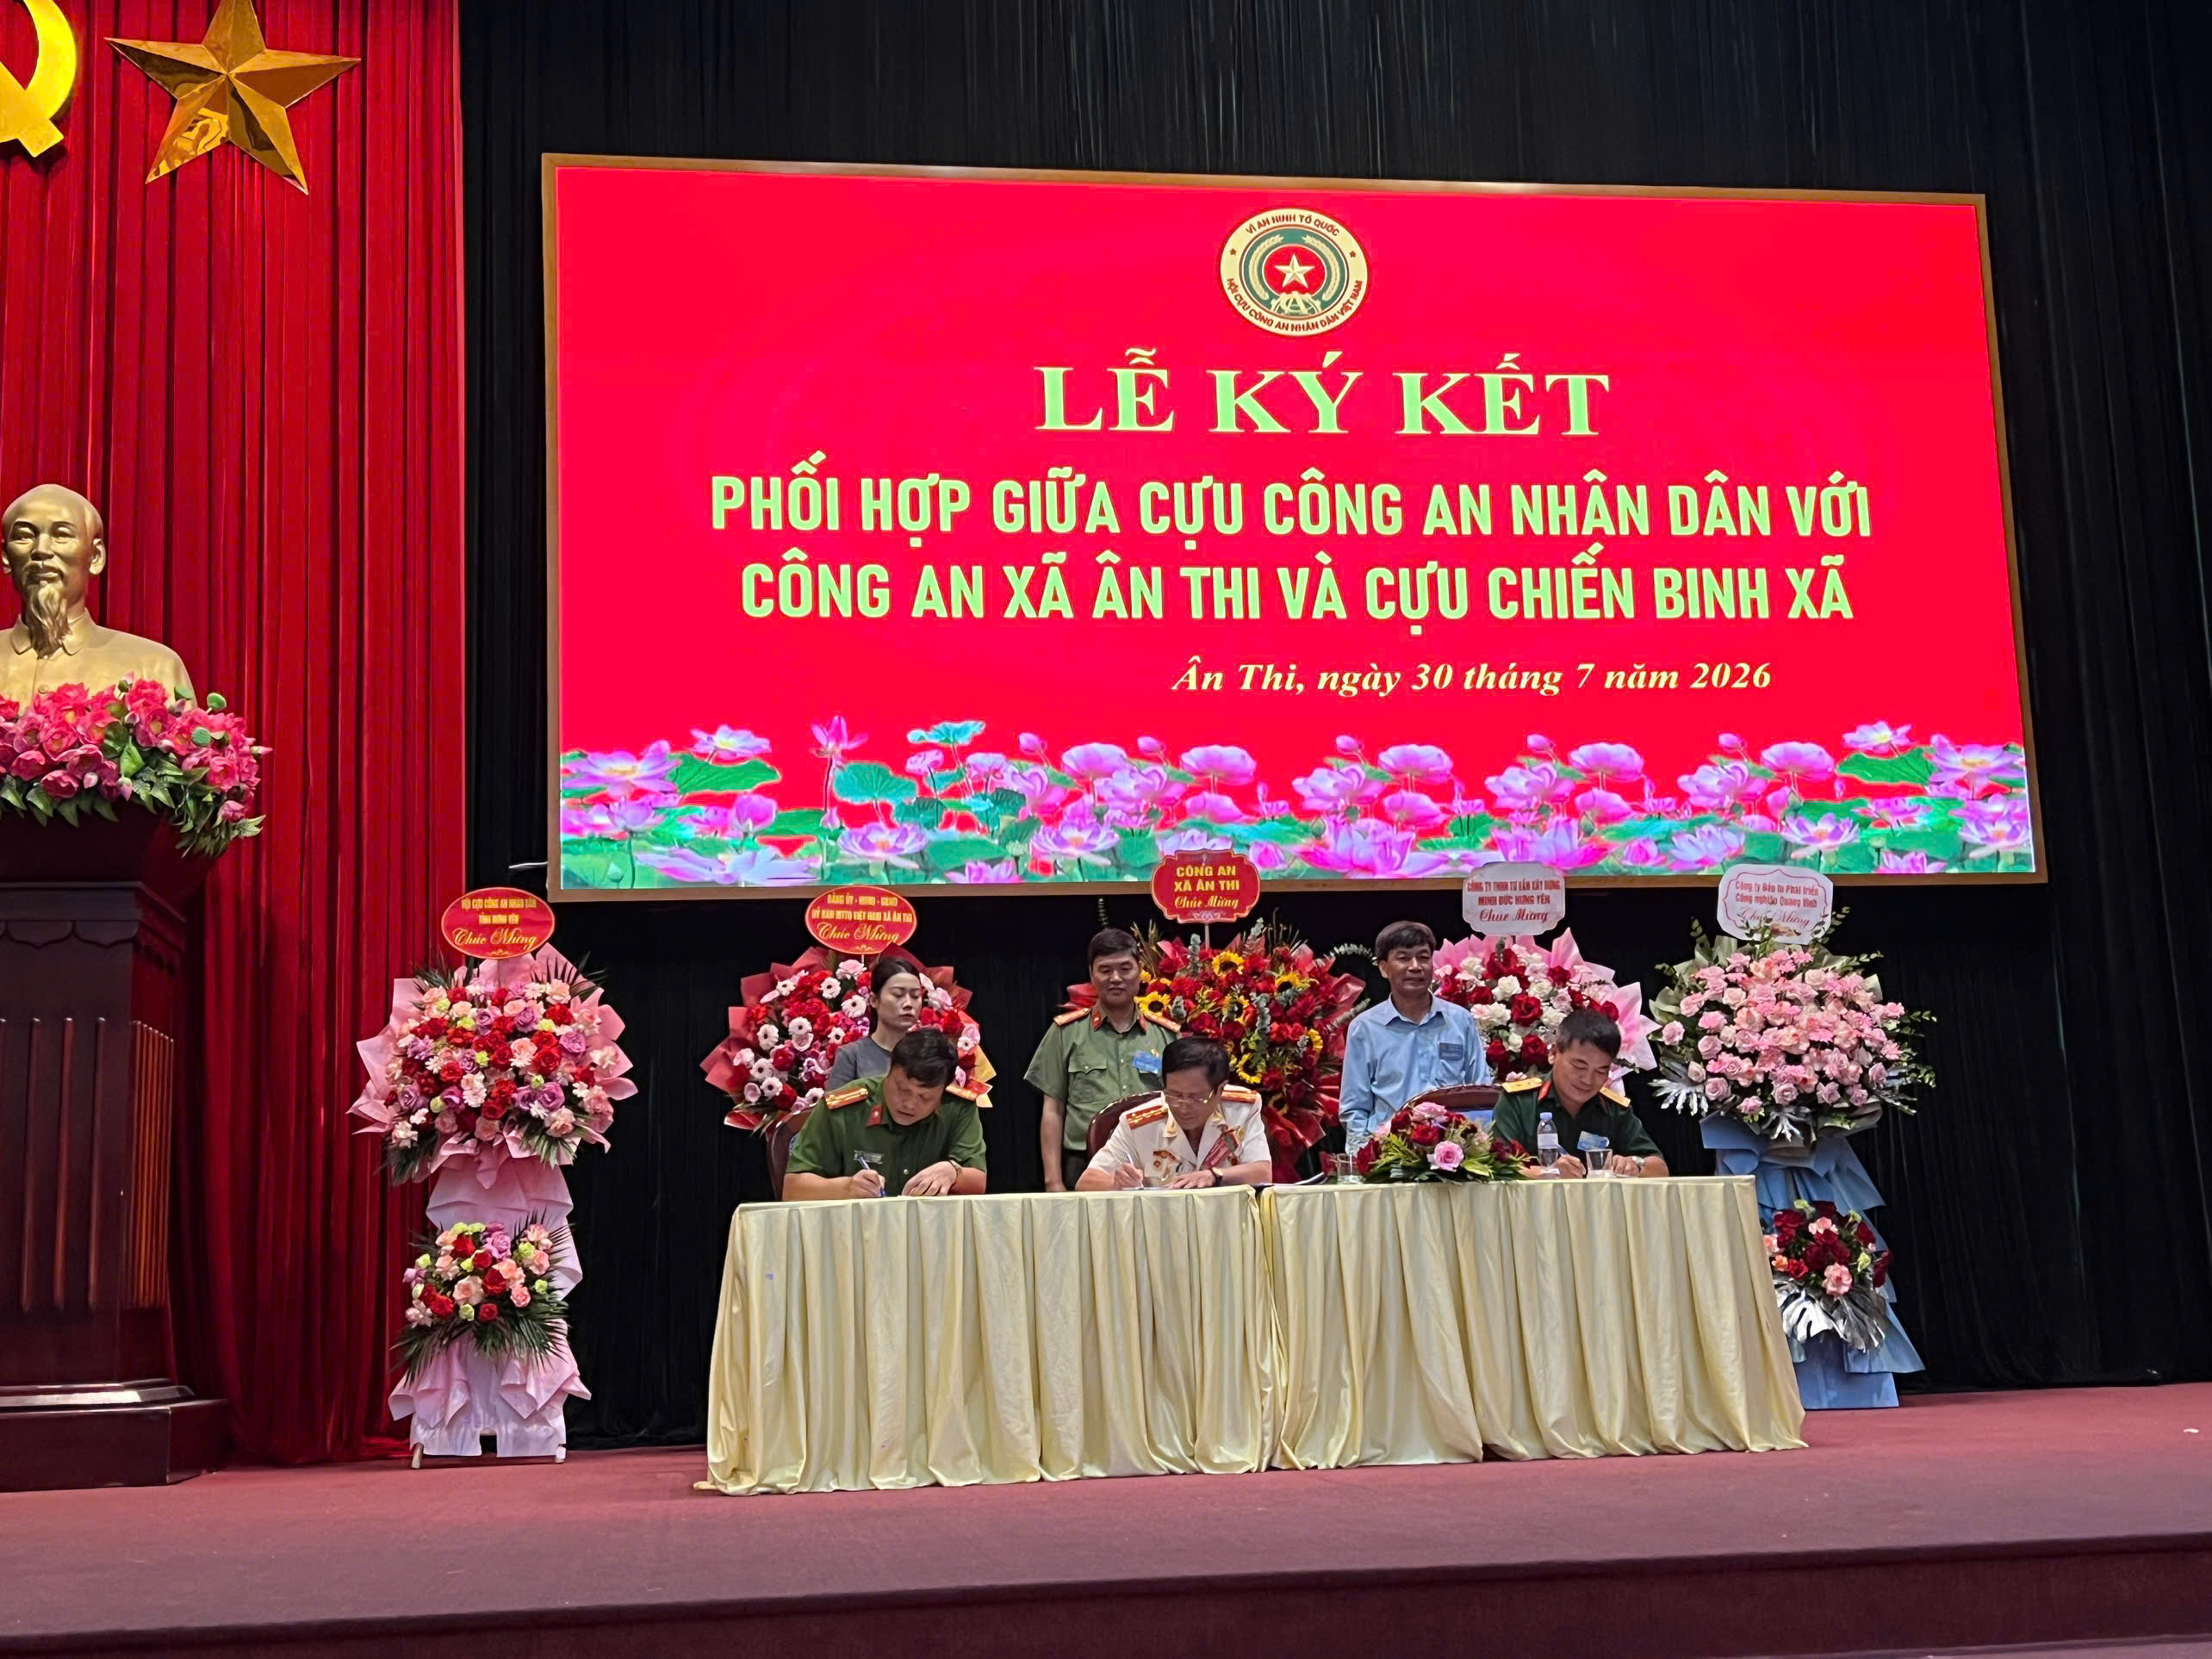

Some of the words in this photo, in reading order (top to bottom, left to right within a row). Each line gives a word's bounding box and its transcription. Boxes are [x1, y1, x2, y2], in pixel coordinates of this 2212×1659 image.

[1257, 218, 1271, 229] AN
[1271, 214, 1296, 224] NINH
[1249, 308, 1274, 327] CÔNG
[1275, 320, 1289, 332] AN
[1290, 320, 1320, 332] NHÂN
[1320, 312, 1340, 328] DÂN
[1350, 280, 1364, 301] NAM
[1034, 347, 1175, 432] LỄ
[1206, 351, 1363, 434] KÝ
[1393, 352, 1609, 436] KẾT
[712, 450, 839, 531] PHỐI
[861, 473, 970, 547] HỢP
[993, 467, 1120, 533] GIỮA
[1140, 475, 1243, 550] CỰU
[1264, 467, 1402, 535] CÔNG
[1423, 484, 1492, 535] AN
[1511, 469, 1649, 535] NHÂN
[1668, 469, 1770, 536] DÂN
[1786, 471, 1870, 537] VỚI
[743, 547, 890, 618] CÔNG
[911, 565, 984, 618] AN
[1003, 551, 1073, 618] XÃ
[1092, 550, 1163, 618] ÂN
[1180, 567, 1260, 618] THI
[1277, 551, 1346, 619] VÀ
[1366, 561, 1468, 635] CỰU
[1488, 542, 1634, 619] CHIẾN
[1654, 568, 1769, 618] BINH
[1785, 555, 1854, 618] XÃ
[1171, 656, 1223, 690] Ân
[1239, 664, 1304, 694] Thi,
[1318, 663, 1401, 697] ngày
[1412, 664, 1452, 690] 30
[1464, 662, 1563, 696] tháng
[1578, 664, 1594, 687] 7
[1605, 664, 1678, 689] năm
[1690, 663, 1770, 688] 2026
[1176, 864, 1214, 877] CÔNG
[1217, 865, 1237, 876] AN
[1174, 879, 1192, 892] XÃ
[1196, 879, 1215, 892] ÂN
[1218, 879, 1240, 891] THI
[1174, 894, 1202, 909] Chúc
[452, 928, 487, 946] Chúc
[490, 928, 537, 950] Mừng
[817, 922, 850, 940] Chúc
